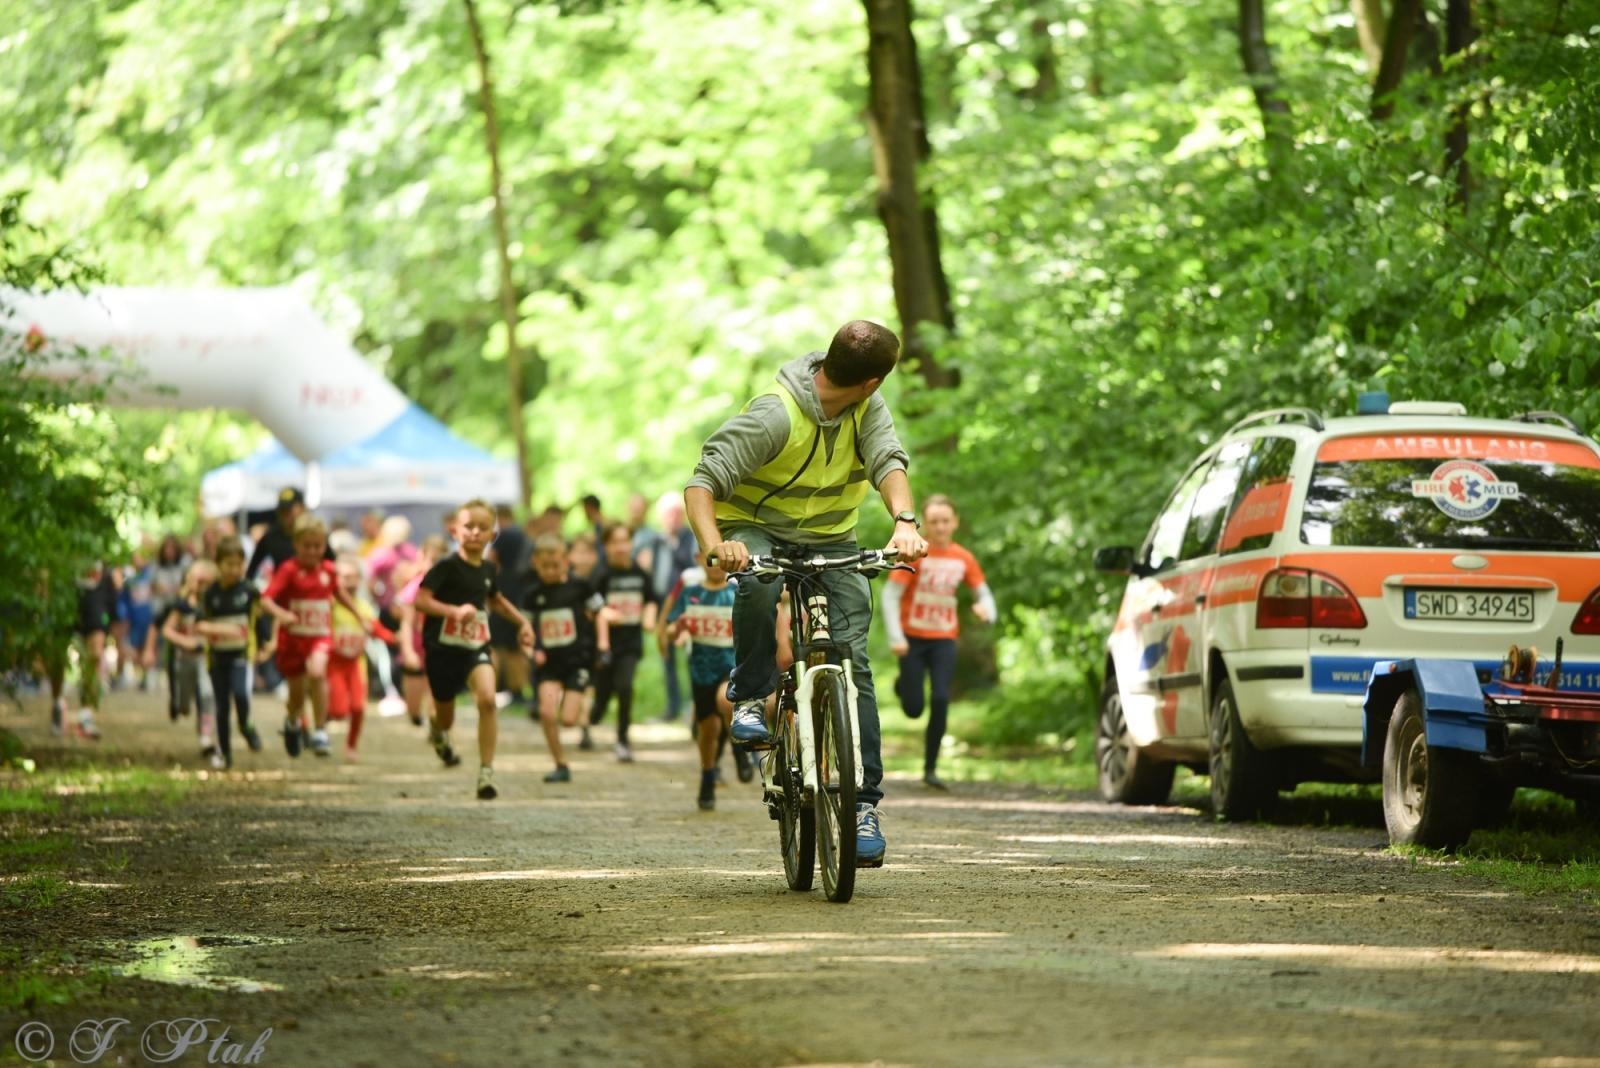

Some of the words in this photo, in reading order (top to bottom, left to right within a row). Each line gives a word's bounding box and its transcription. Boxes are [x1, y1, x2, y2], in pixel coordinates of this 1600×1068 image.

[1373, 436, 1548, 458] AMBULANS
[1414, 484, 1445, 493] FIRE
[1484, 484, 1516, 495] MED
[1418, 594, 1459, 616] SWD
[1466, 594, 1530, 617] 34945
